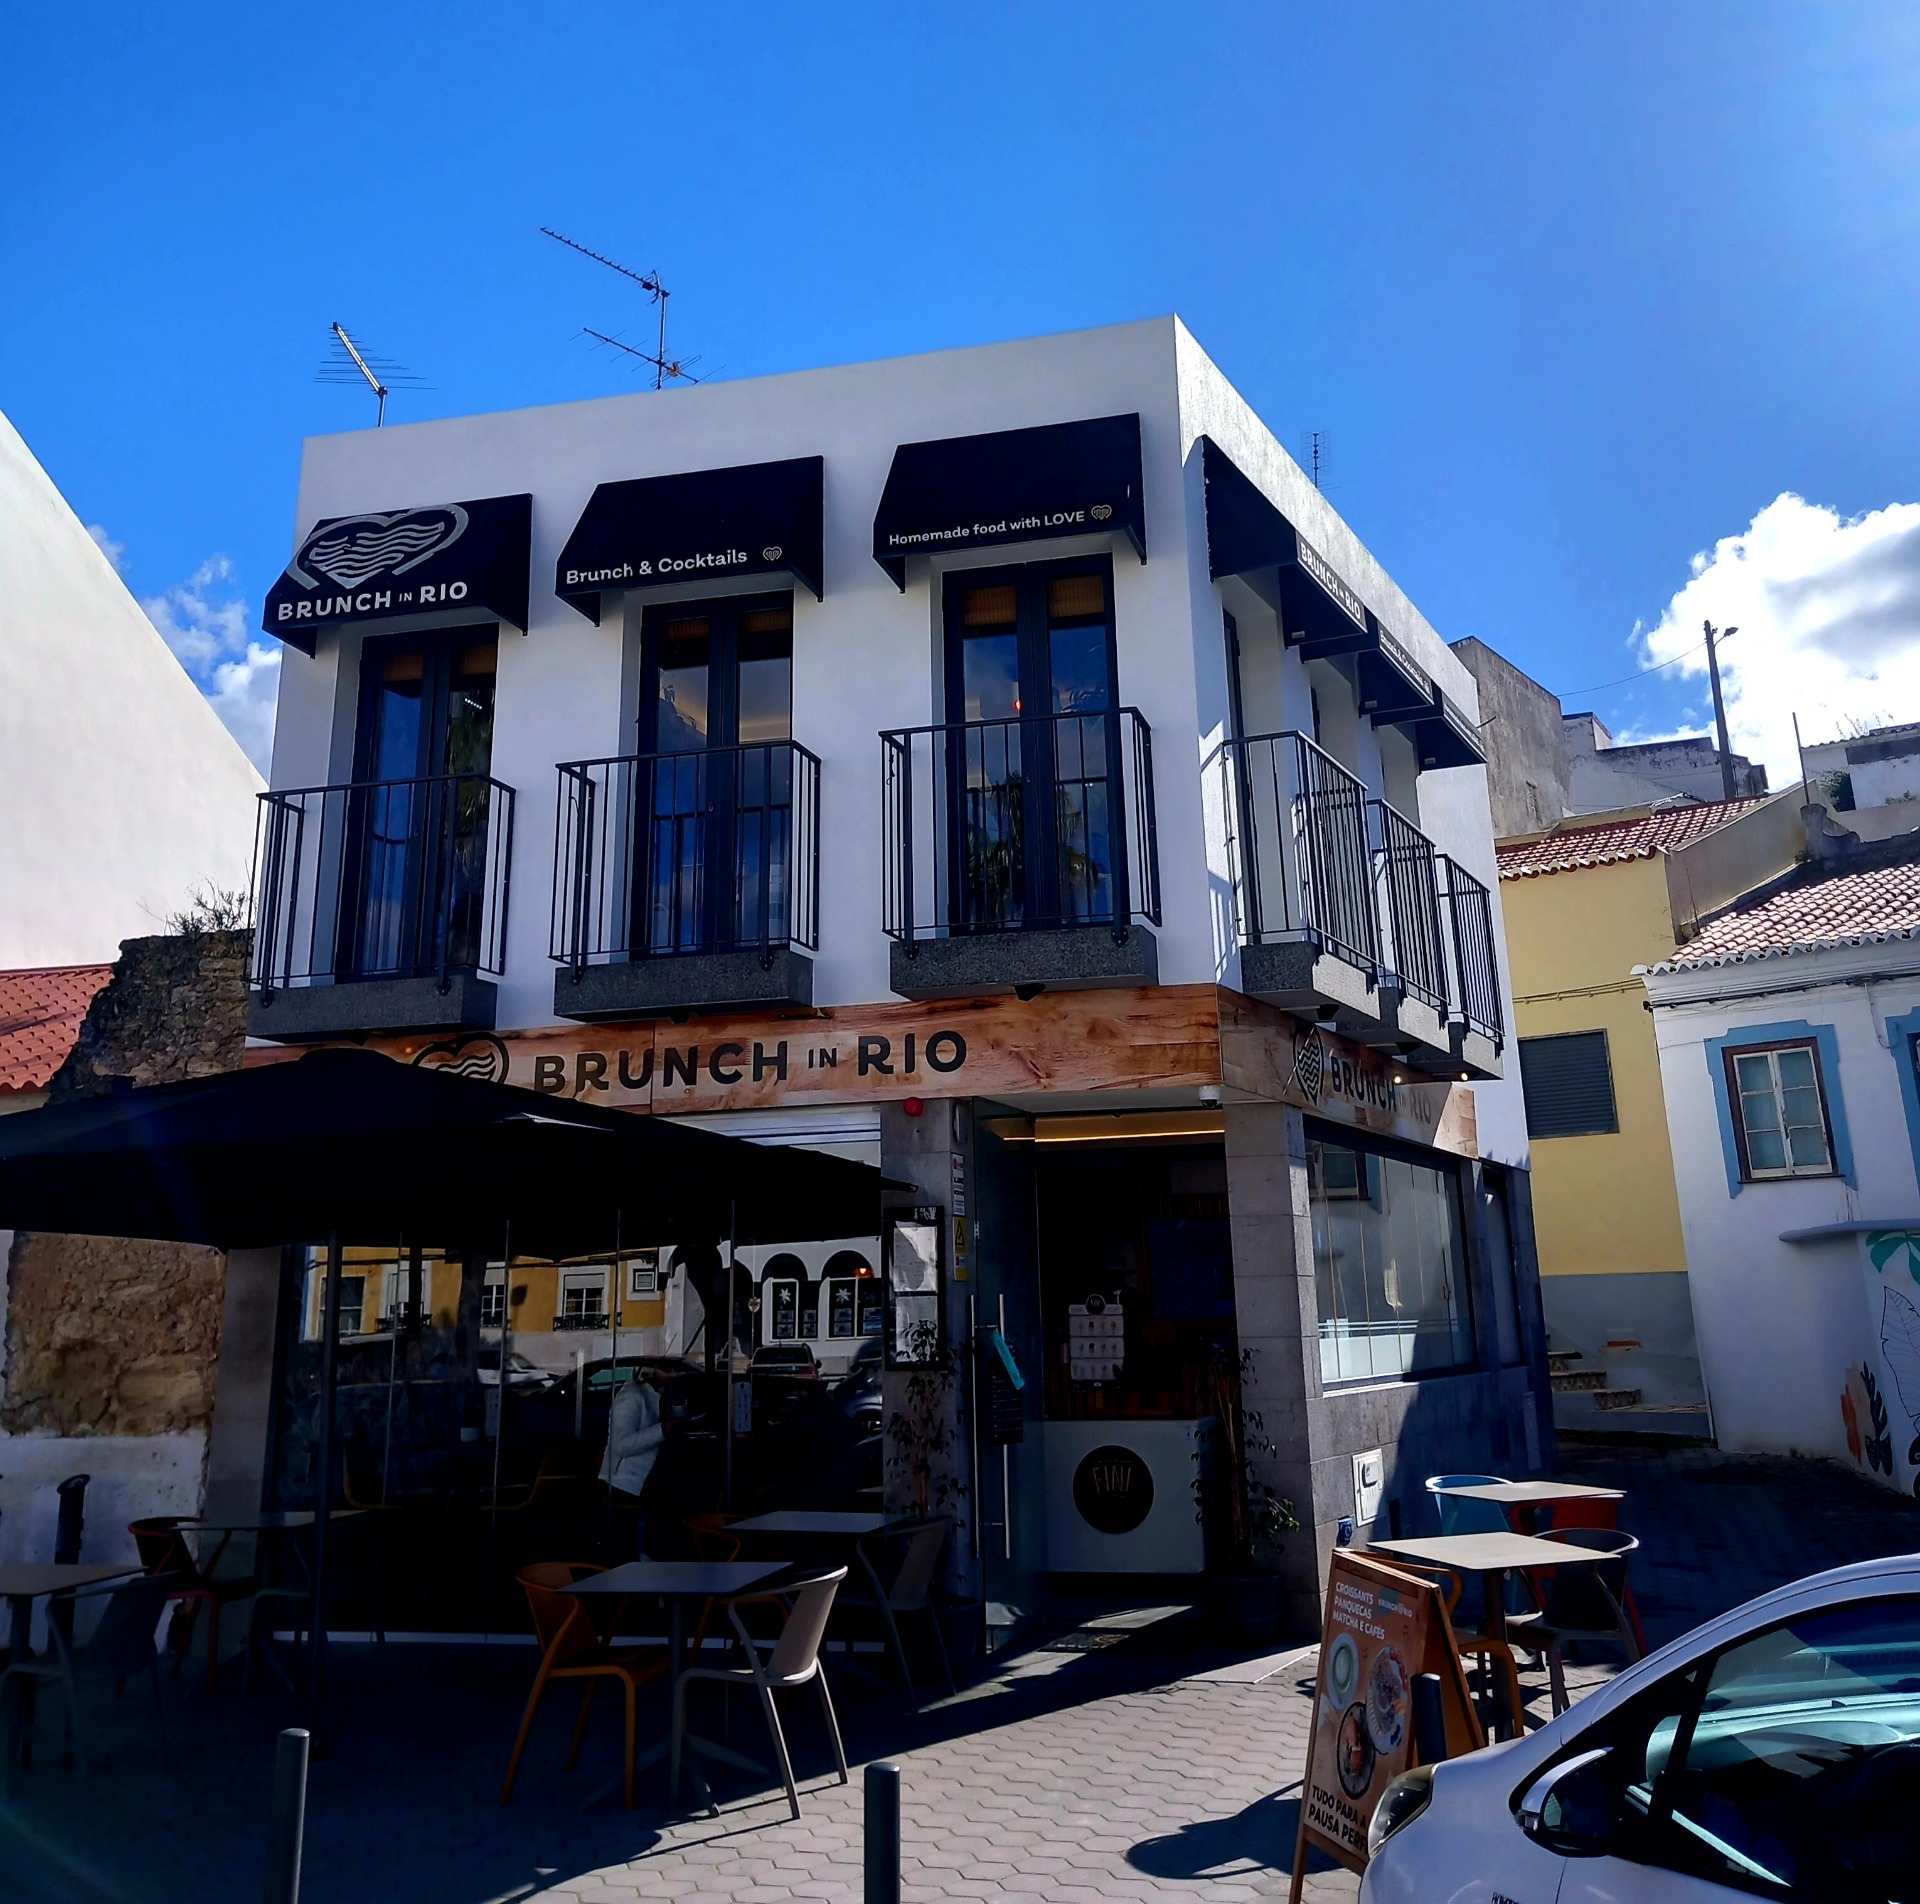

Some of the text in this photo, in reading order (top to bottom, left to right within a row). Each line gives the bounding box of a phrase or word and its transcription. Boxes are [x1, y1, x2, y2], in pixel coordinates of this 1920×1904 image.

[889, 510, 1085, 545] Homemade food with LOVE
[566, 549, 748, 584] Brunch & Cocktails
[1300, 541, 1360, 619] BRUNCH RIO
[278, 581, 468, 621] BRUNCH IN RIO
[533, 1030, 968, 1094] BRUNCH IN RIO
[1331, 1056, 1396, 1112] BRUNCH
[1409, 1087, 1432, 1124] RIO
[1092, 1465, 1132, 1494] FINI
[1334, 1596, 1372, 1619] PANQUECAS
[1336, 1582, 1373, 1605] CROISSANTS
[1332, 1610, 1358, 1629] MATCHA
[1360, 1621, 1364, 1631] E
[1308, 1803, 1339, 1836] PAUSA
[1312, 1785, 1335, 1809] TUDO
[1336, 1799, 1358, 1825] PARA
